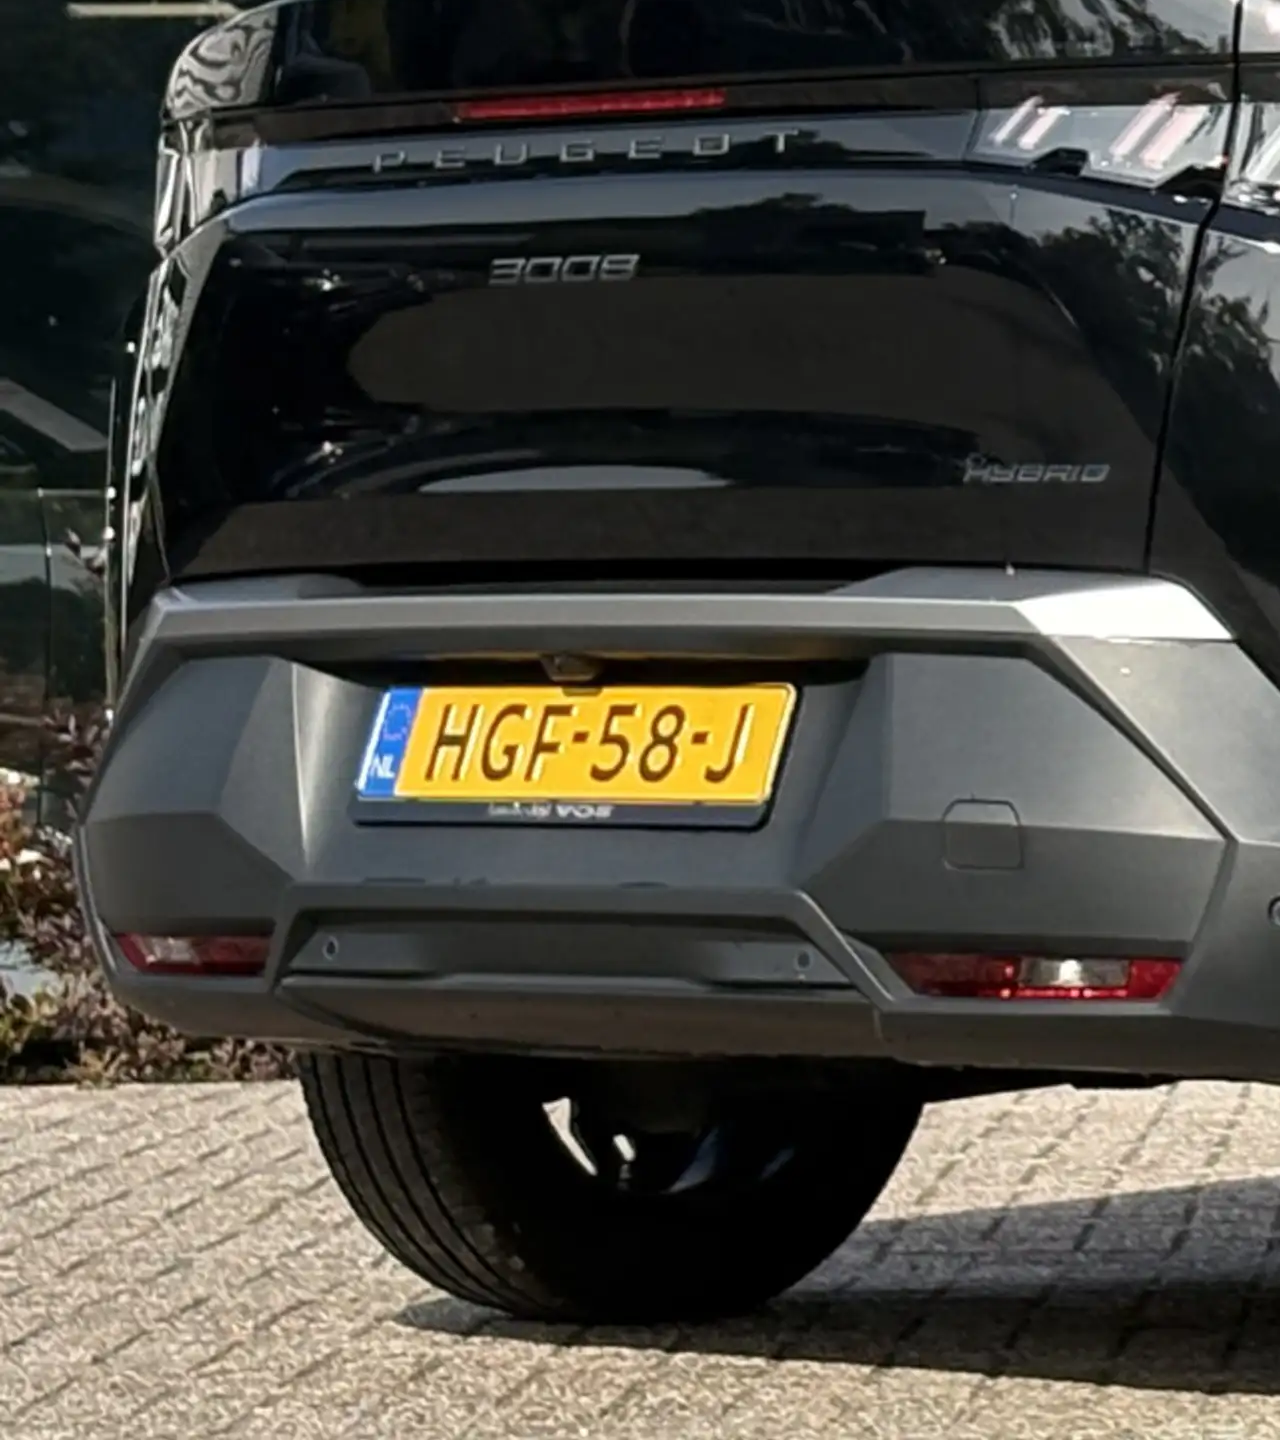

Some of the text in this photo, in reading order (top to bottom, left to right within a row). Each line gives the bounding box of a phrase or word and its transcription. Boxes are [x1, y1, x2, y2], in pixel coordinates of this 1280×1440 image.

[372, 128, 798, 173] PEUGEOT
[489, 254, 641, 286] 3008
[424, 702, 754, 783] HGF-58-J
[367, 753, 396, 779] NL
